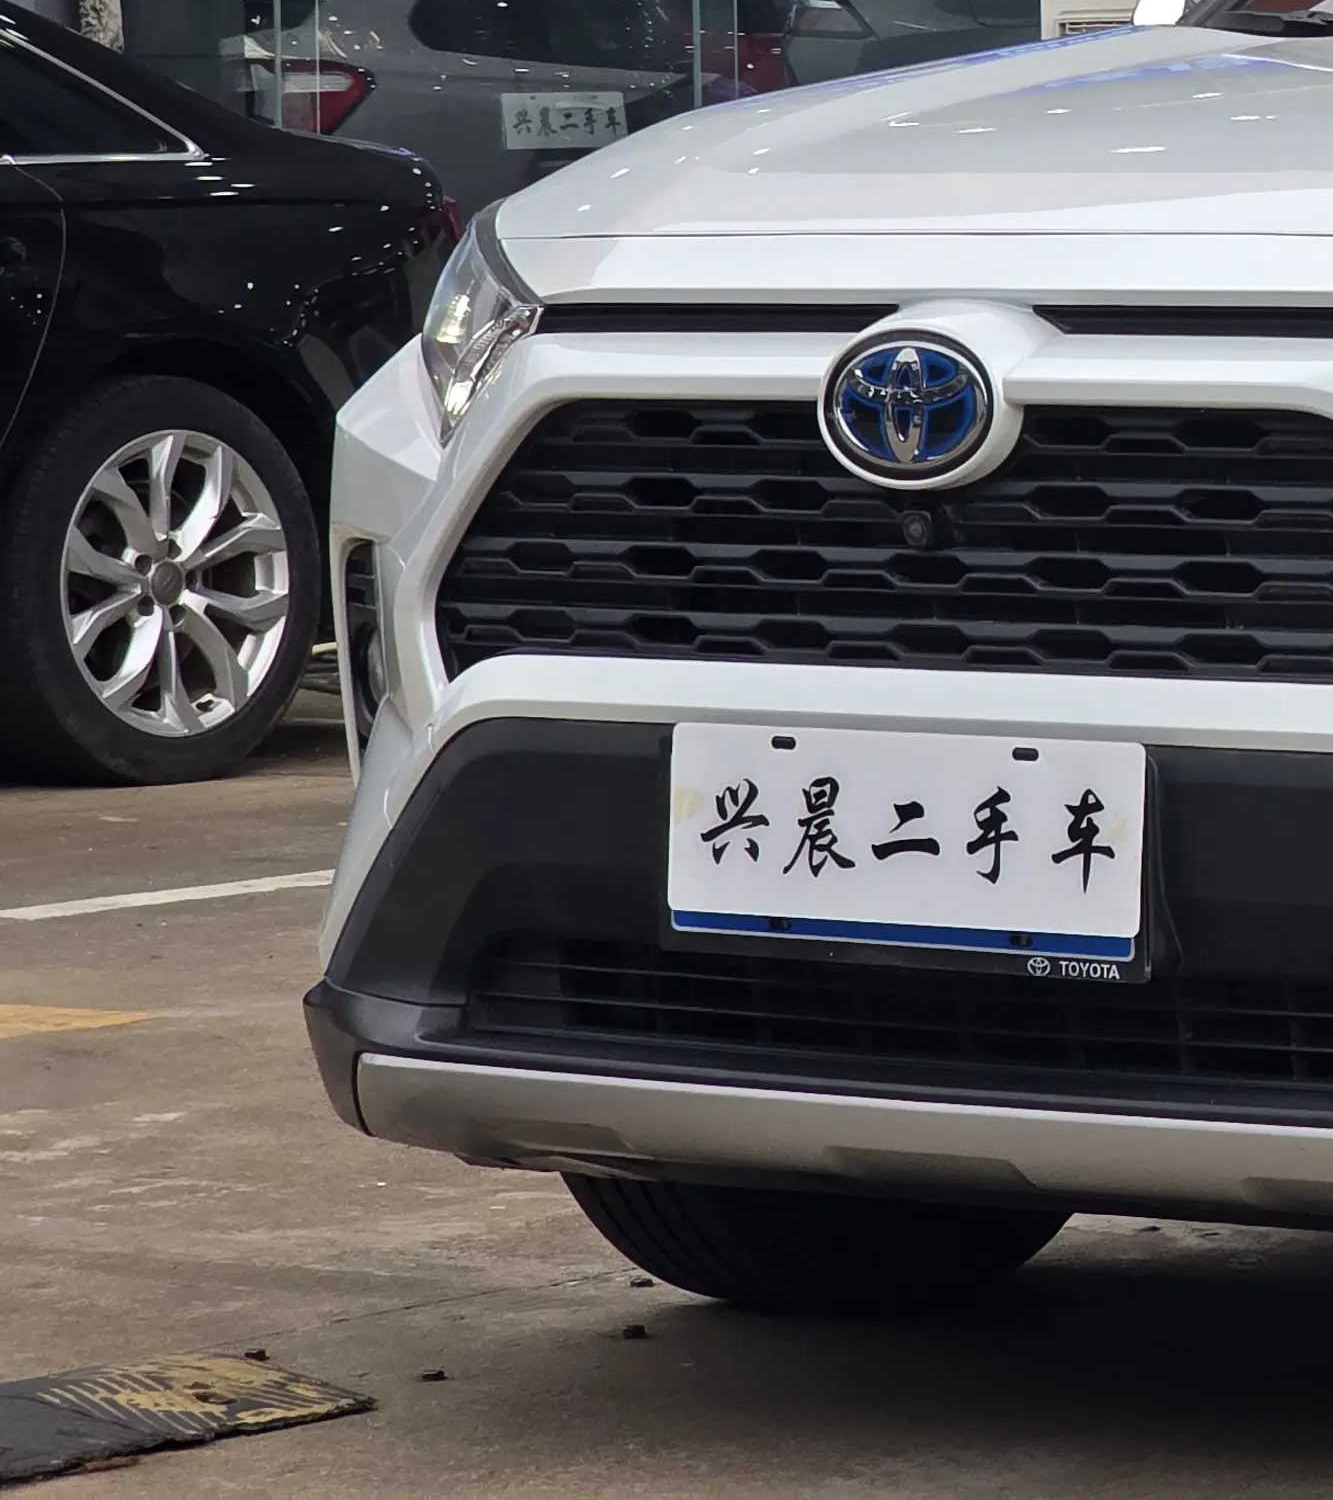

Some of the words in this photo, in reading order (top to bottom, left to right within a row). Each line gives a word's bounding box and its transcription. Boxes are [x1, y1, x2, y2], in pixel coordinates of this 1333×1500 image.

[513, 106, 621, 138] 兴晨二手车
[700, 776, 1115, 894] 兴晨二手车
[1059, 961, 1120, 980] TOYOTA
